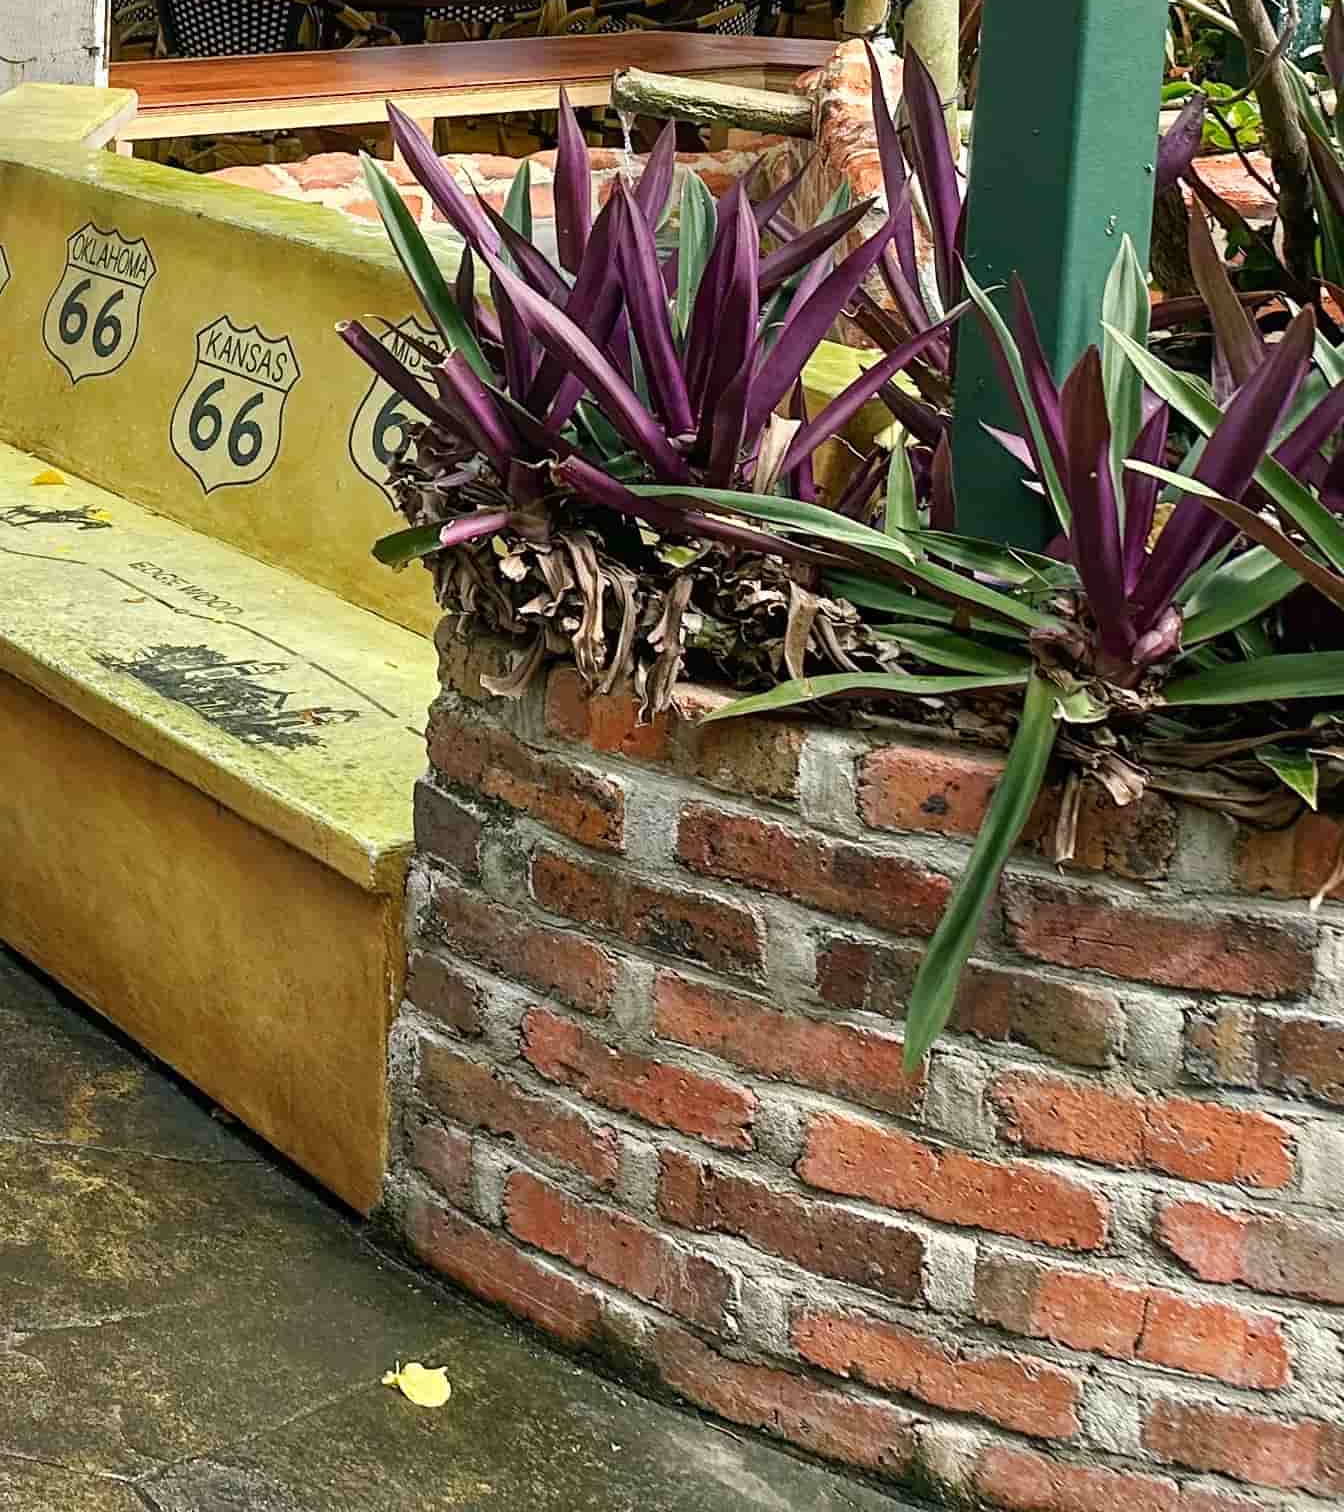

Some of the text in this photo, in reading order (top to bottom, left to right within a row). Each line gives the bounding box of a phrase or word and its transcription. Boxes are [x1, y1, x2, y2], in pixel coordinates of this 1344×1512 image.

[71, 232, 149, 281] OKLAHOMA
[59, 278, 124, 358] 66
[206, 330, 288, 384] KANSAS
[189, 377, 264, 467] 66
[127, 559, 246, 616] EDGEWOOD
